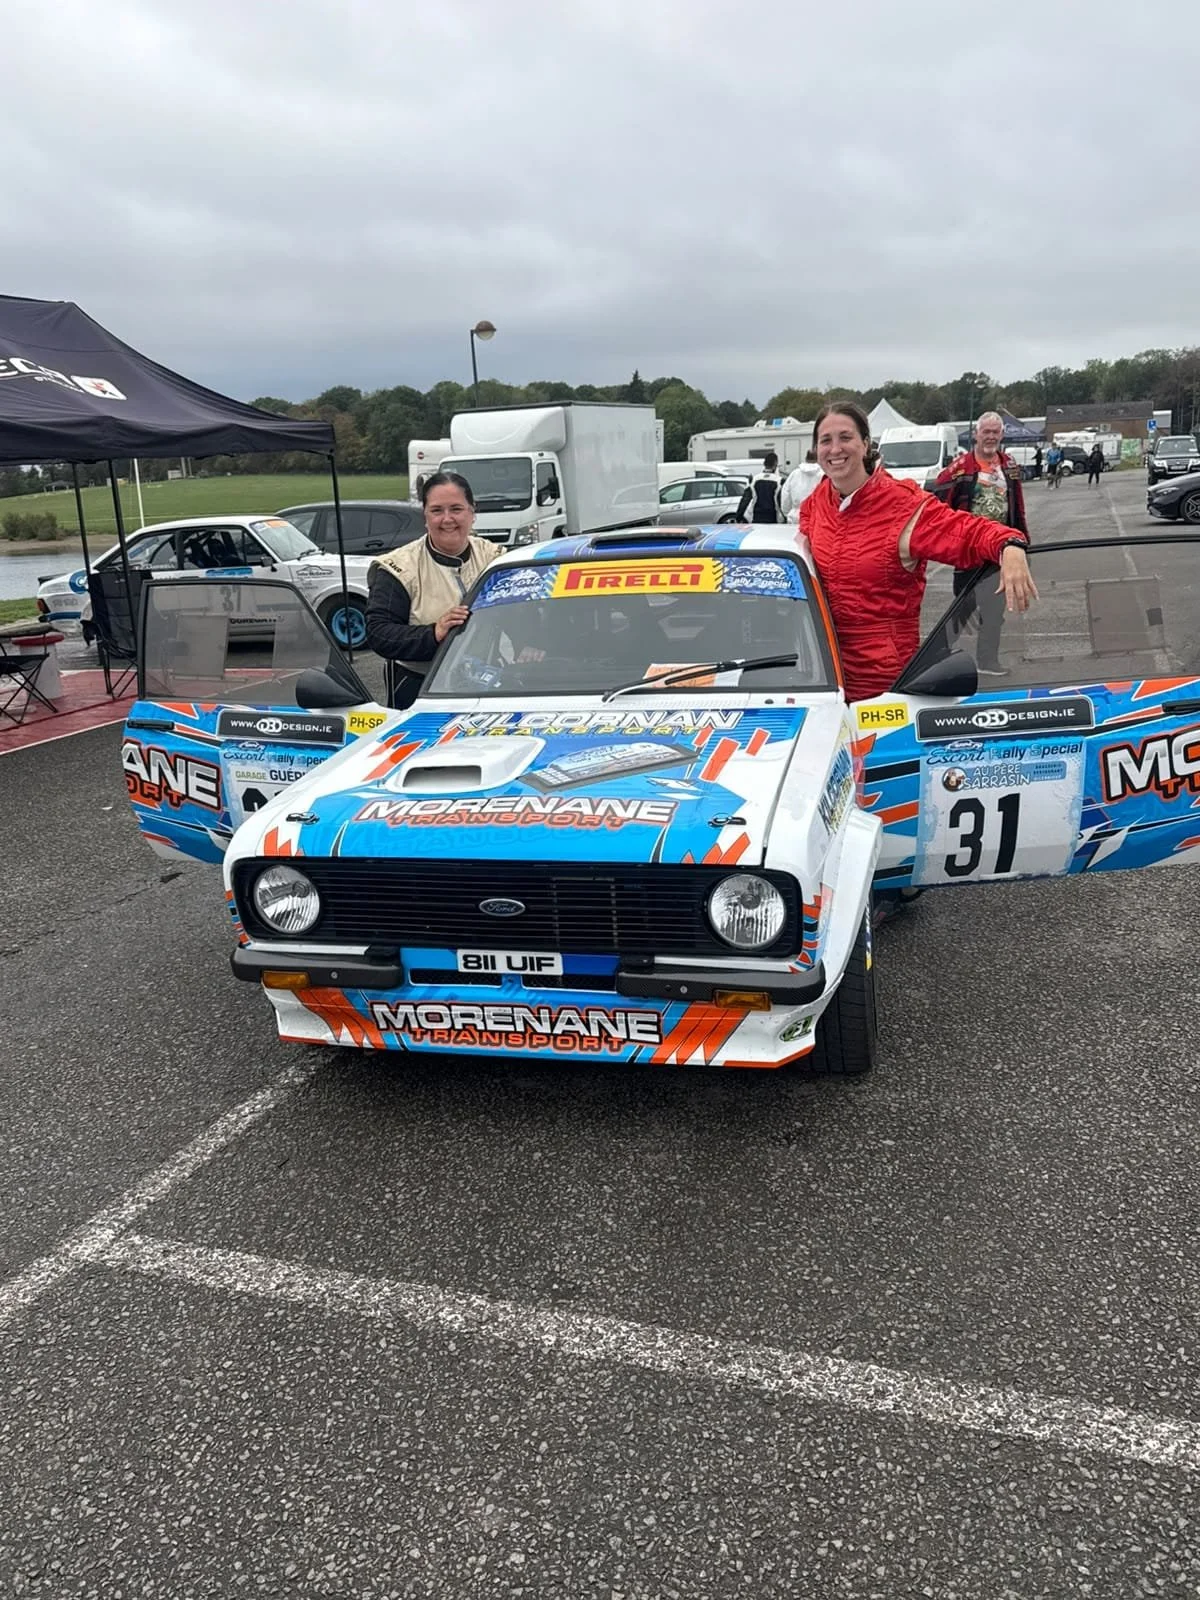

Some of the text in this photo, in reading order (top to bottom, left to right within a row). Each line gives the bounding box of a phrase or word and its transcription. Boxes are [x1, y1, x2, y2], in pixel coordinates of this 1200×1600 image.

[564, 564, 704, 590] PIRELLI
[438, 710, 745, 731] KILCORNAN
[861, 709, 905, 723] PH-SR
[464, 725, 704, 737] TRANSPORT
[926, 748, 985, 766] Escort
[990, 746, 1030, 762] Rally
[1031, 742, 1083, 759] Special
[973, 765, 989, 777] AU
[993, 763, 1021, 775] PÈRE
[963, 772, 1031, 790] SARRASIN
[355, 796, 679, 822] MORENANE
[389, 812, 631, 827] TRANSPORT
[944, 793, 1020, 877] 31
[488, 902, 516, 912] Ford
[462, 954, 555, 972] 811 UIF
[371, 1003, 661, 1043] MORENANE
[411, 1028, 626, 1051] TRANSPORT
